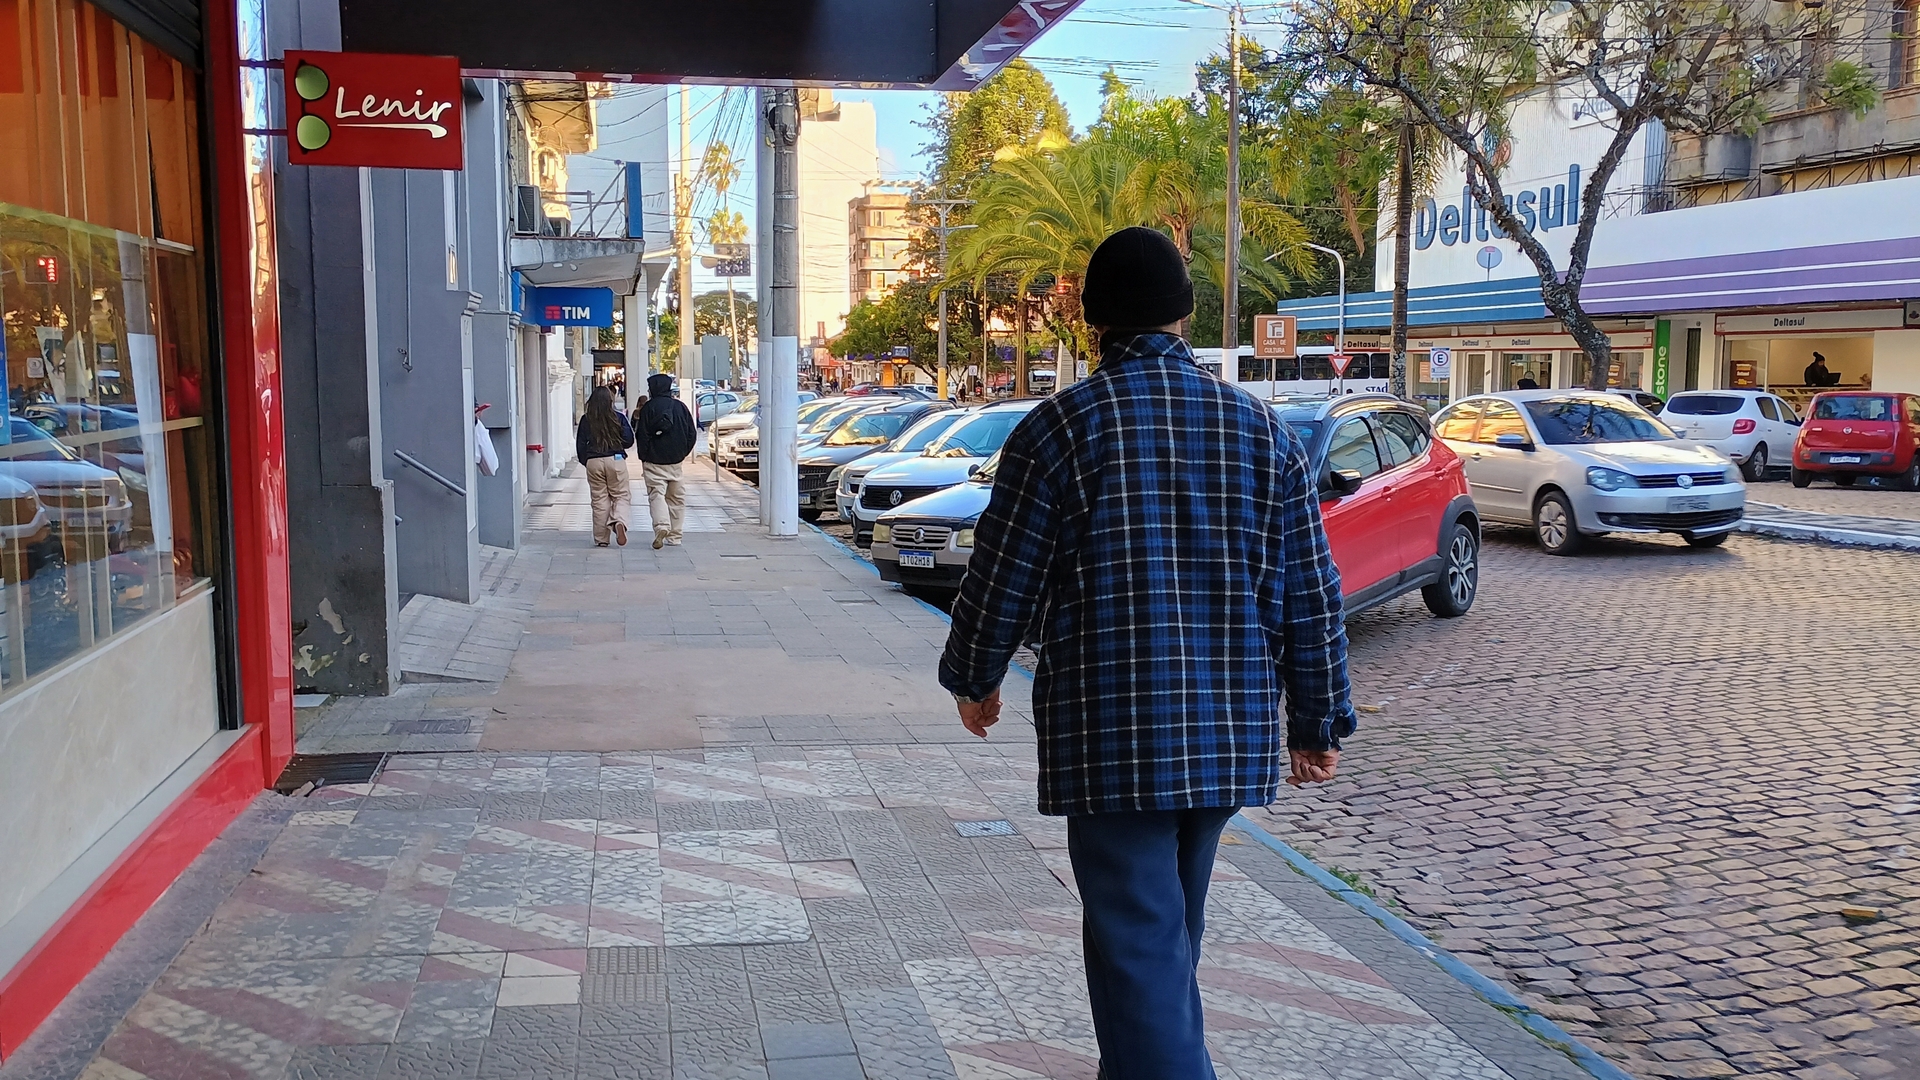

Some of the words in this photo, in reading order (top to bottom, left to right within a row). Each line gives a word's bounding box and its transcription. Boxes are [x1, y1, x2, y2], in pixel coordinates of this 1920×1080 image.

[335, 86, 453, 122] Lenir
[561, 306, 591, 320] TIM
[1774, 317, 1805, 327] Deltasul
[1347, 340, 1379, 348] Deltasul
[1437, 354, 1444, 363] E
[1655, 345, 1667, 395] stone
